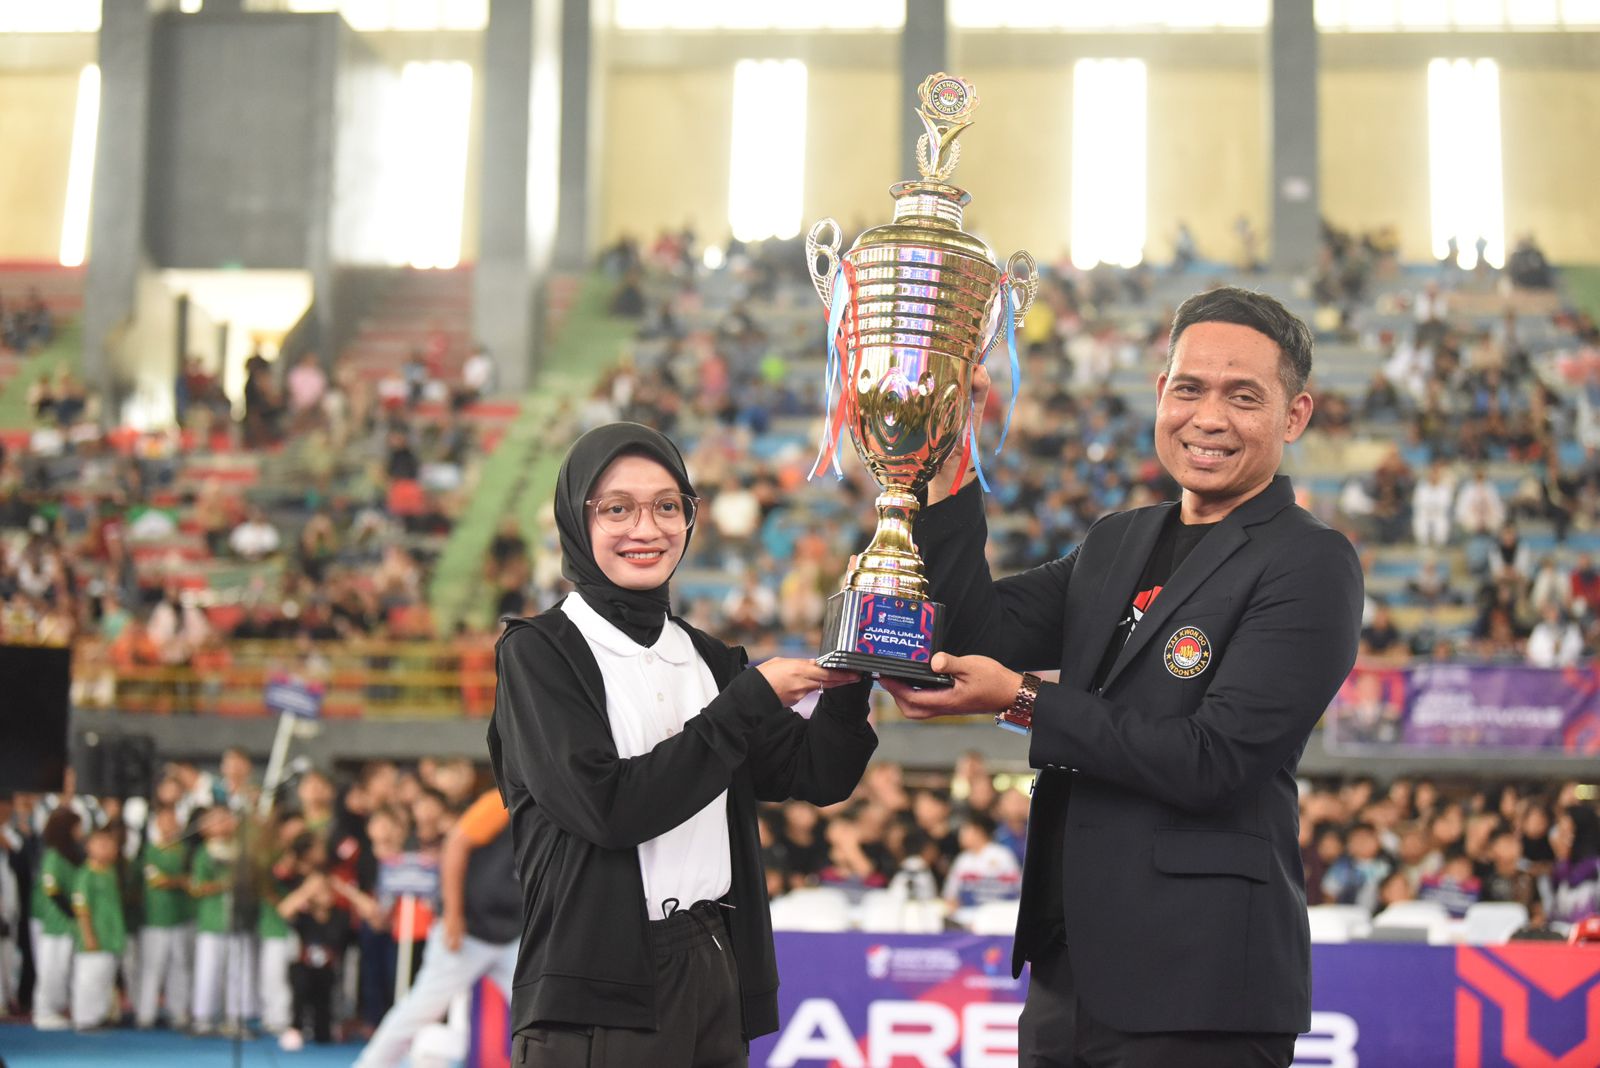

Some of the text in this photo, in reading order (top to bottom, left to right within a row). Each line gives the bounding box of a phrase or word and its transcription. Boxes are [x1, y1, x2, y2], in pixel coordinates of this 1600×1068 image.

[863, 633, 924, 648] OVERALL
[865, 627, 924, 639] JUARA UMUM
[1168, 629, 1206, 649] TAE KWON DO
[1168, 660, 1207, 676] INDONESIA
[764, 997, 1024, 1068] ARE
